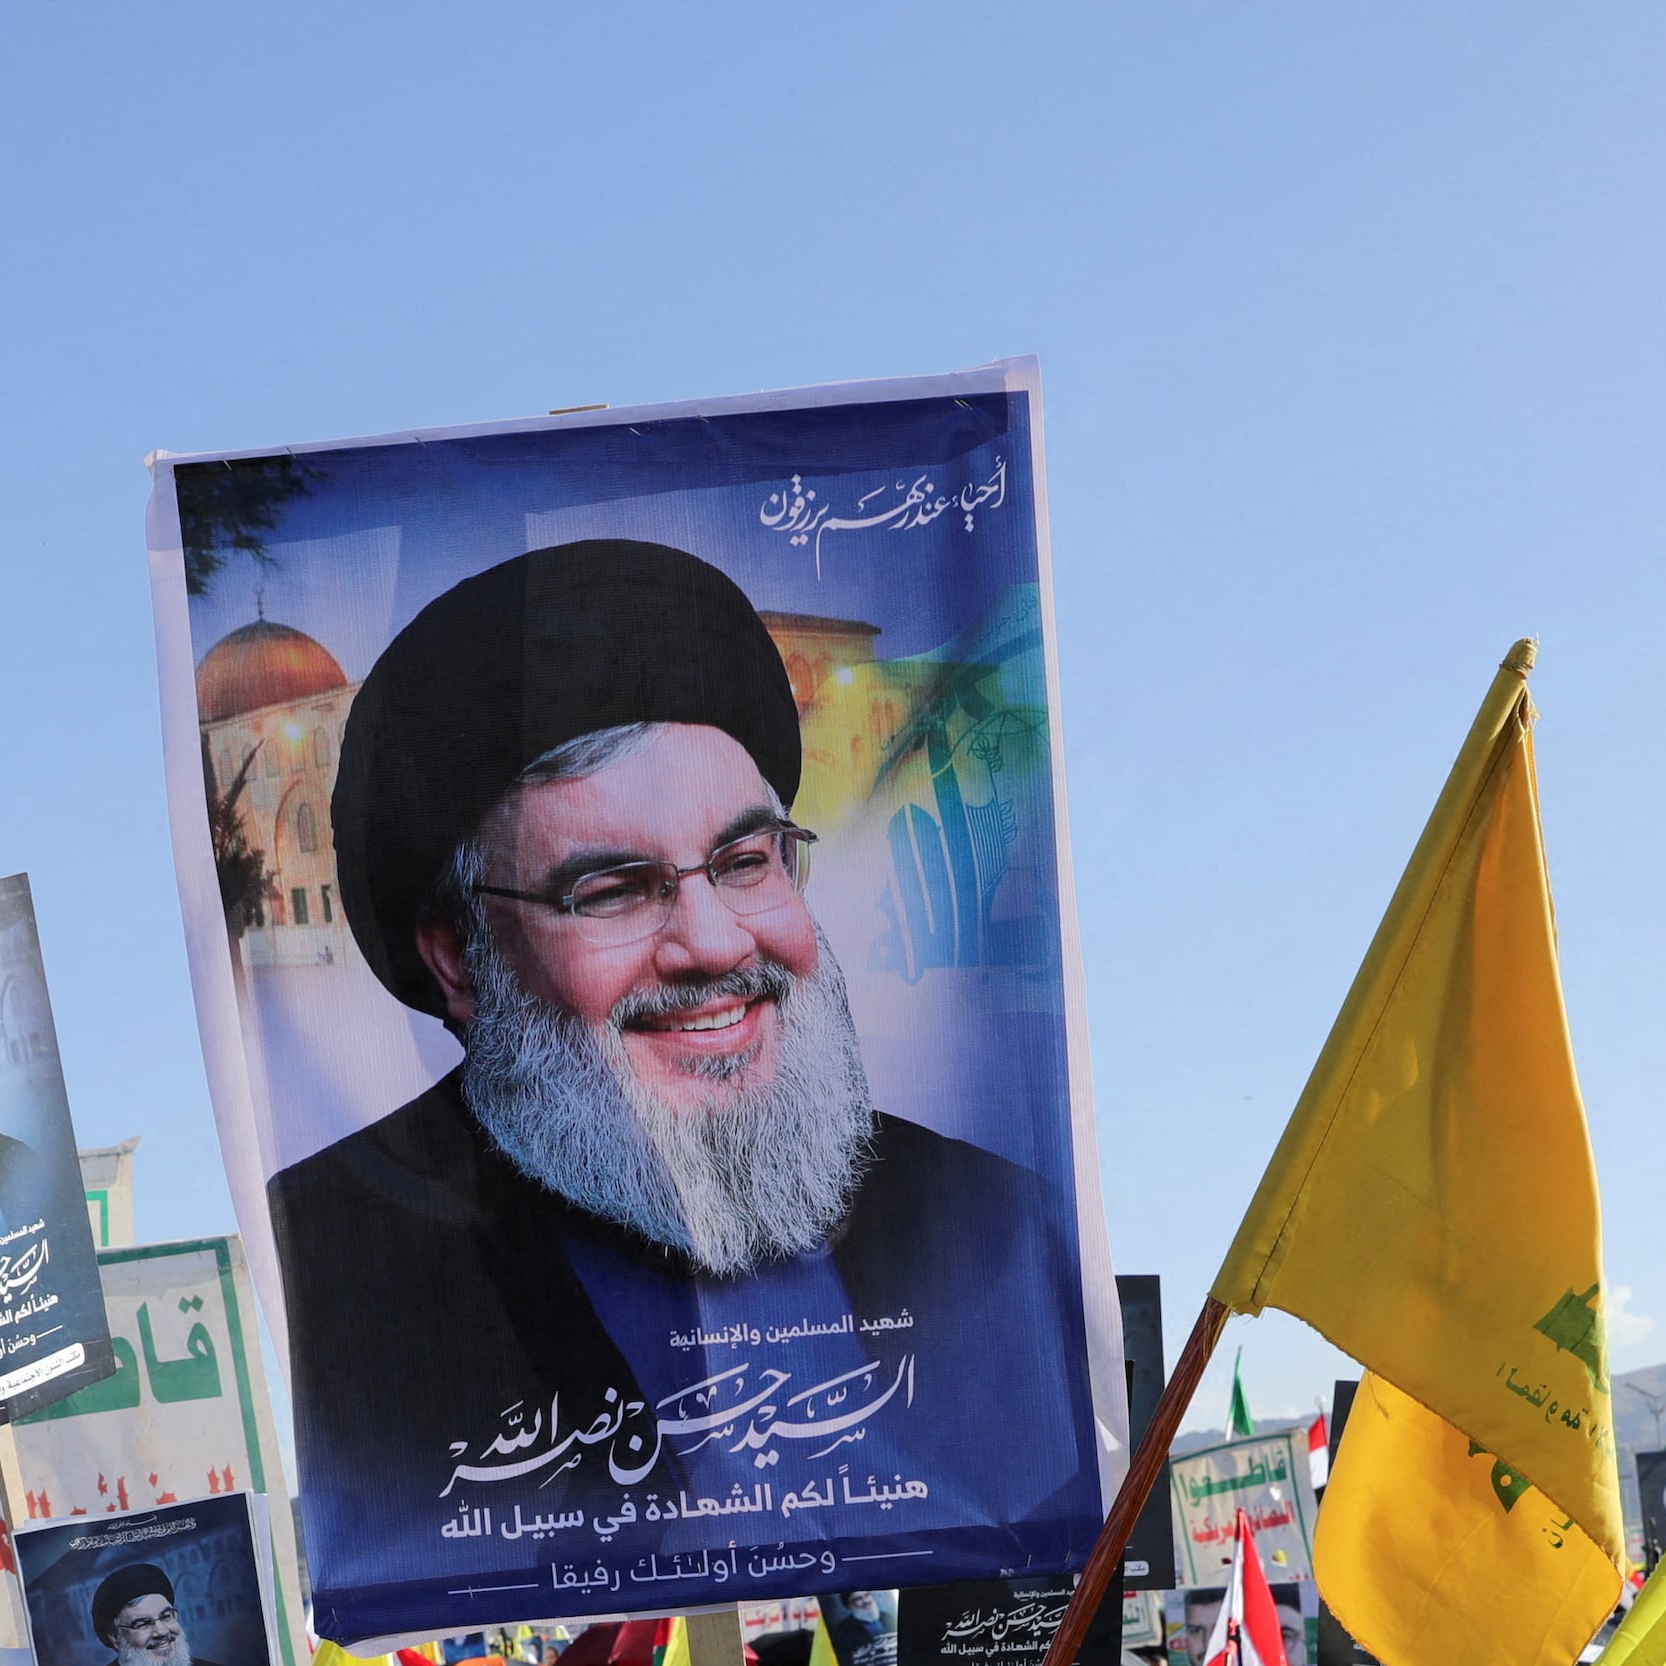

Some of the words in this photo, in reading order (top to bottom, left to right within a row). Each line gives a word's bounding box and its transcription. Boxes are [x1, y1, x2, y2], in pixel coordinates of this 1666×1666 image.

[0, 1225, 34, 1245] المسلمين
[14, 1299, 34, 1323] لكم
[859, 1309, 914, 1335] شهيد
[669, 1322, 762, 1350] والإنسانية
[765, 1316, 855, 1345] المسلمين
[645, 1483, 772, 1523] الشهادة
[781, 1484, 834, 1520] لكم
[440, 1499, 492, 1540] الله
[501, 1501, 584, 1540] سبيل
[593, 1494, 637, 1543] في
[551, 1561, 621, 1595] رفيقا
[940, 1643, 957, 1655] الله
[958, 1644, 984, 1656] سبيل
[985, 1641, 1000, 1658] في
[1000, 1640, 1039, 1652] الشهادة
